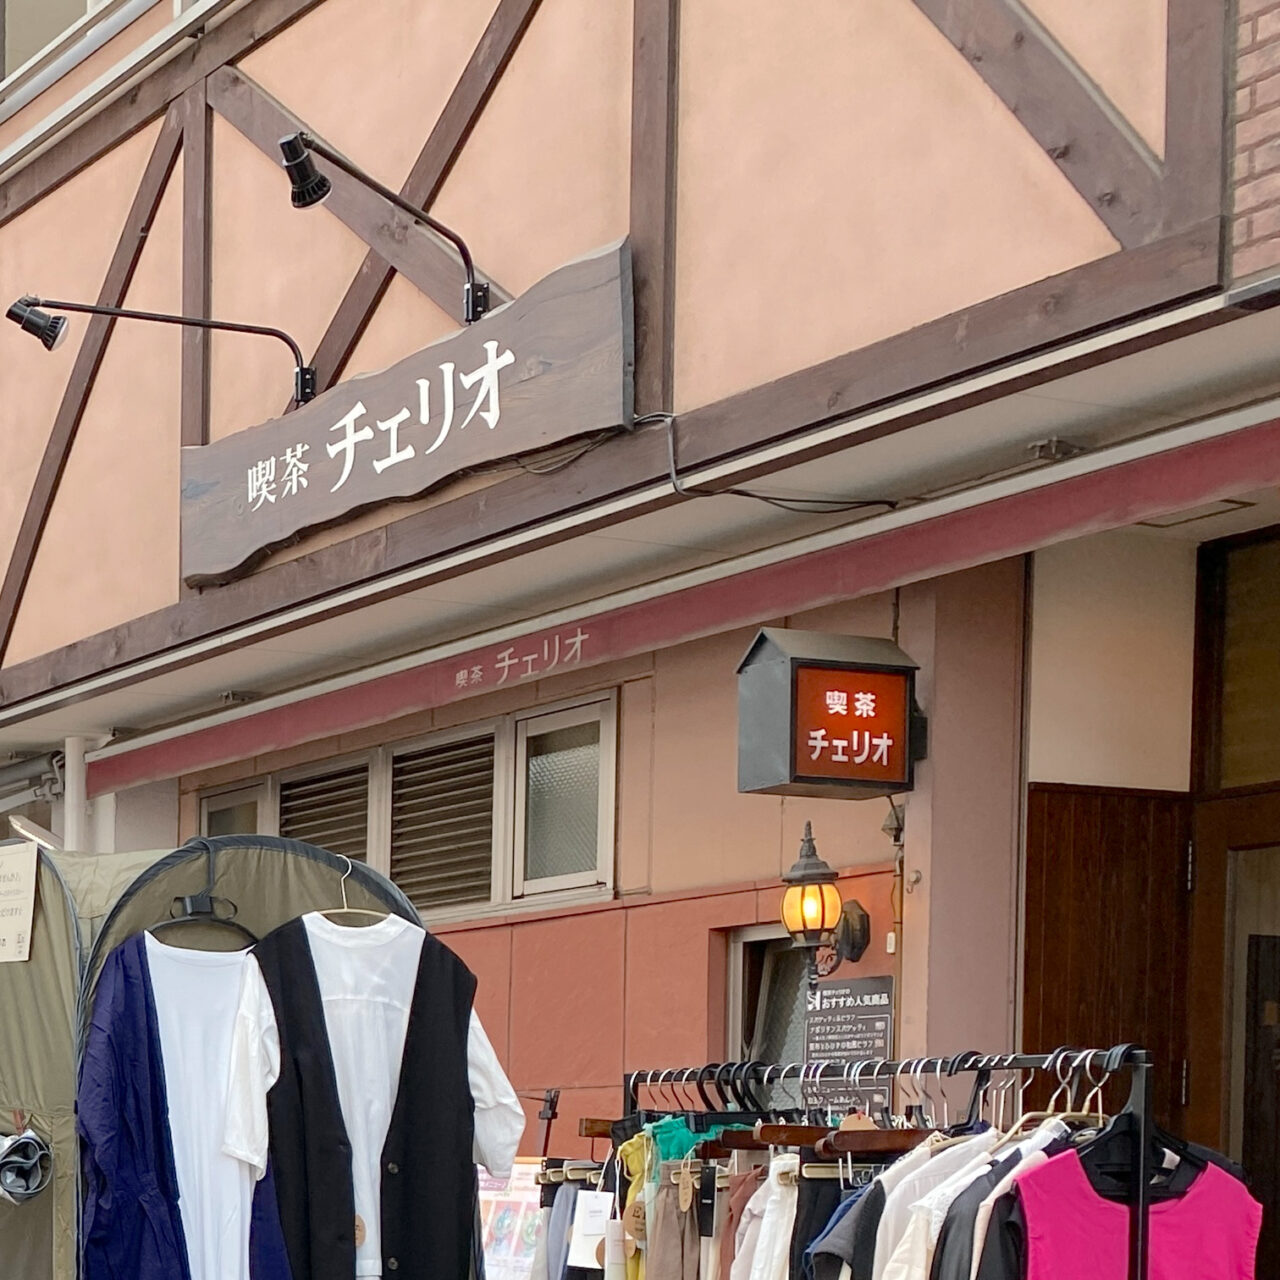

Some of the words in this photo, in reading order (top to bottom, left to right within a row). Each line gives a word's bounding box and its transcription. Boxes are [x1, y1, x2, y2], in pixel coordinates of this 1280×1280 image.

[247, 443, 310, 512] 喫茶
[326, 340, 516, 493] チェリオ
[455, 664, 484, 688] 喫茶
[495, 627, 590, 685] チェリオ
[825, 690, 876, 718] 喫茶
[808, 728, 893, 766] チェリオ
